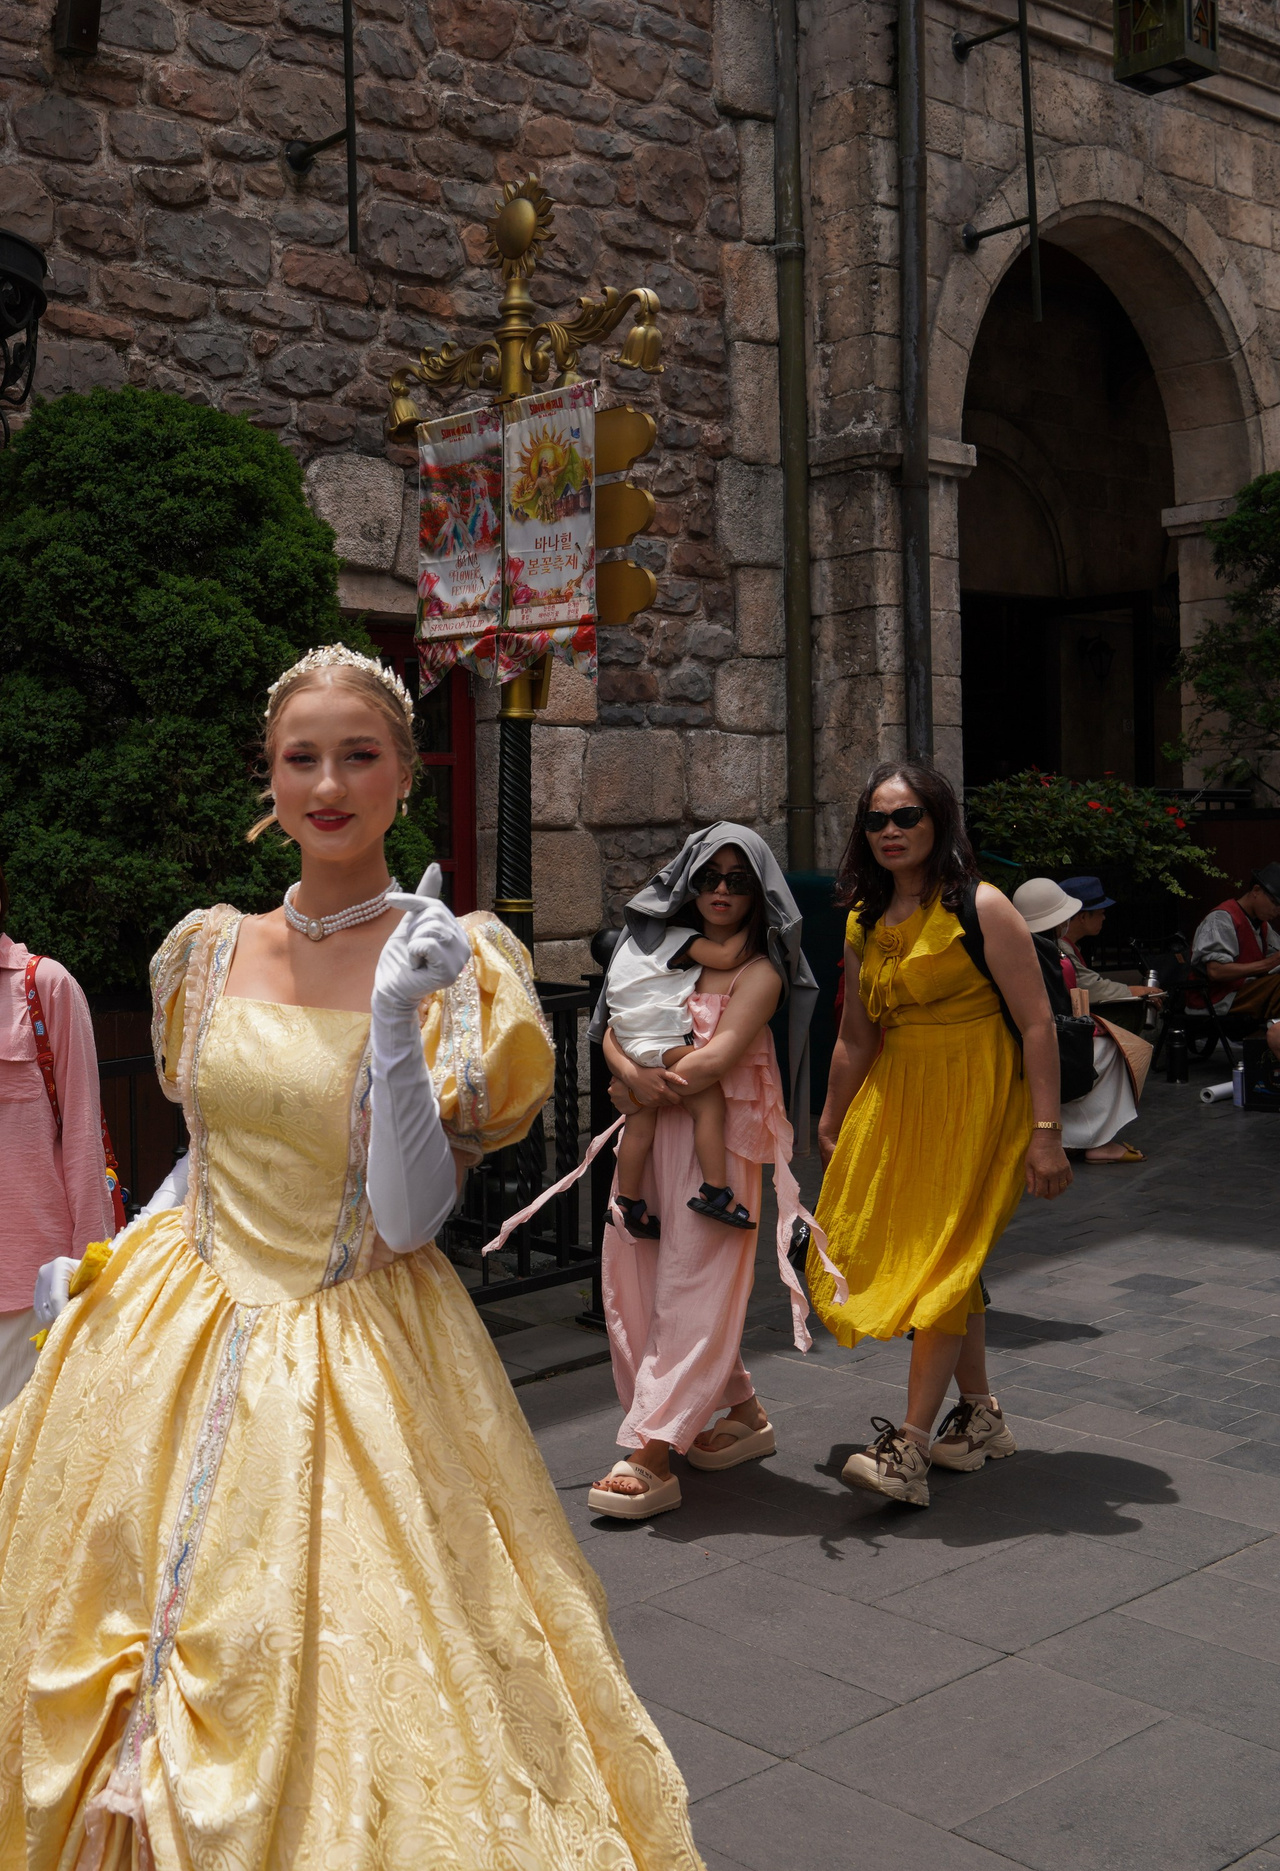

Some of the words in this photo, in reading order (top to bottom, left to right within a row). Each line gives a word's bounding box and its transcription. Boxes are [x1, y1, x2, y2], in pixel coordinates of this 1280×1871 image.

[534, 532, 572, 553] 바나힐
[430, 622, 454, 632] SPRING
[455, 621, 464, 630] OF
